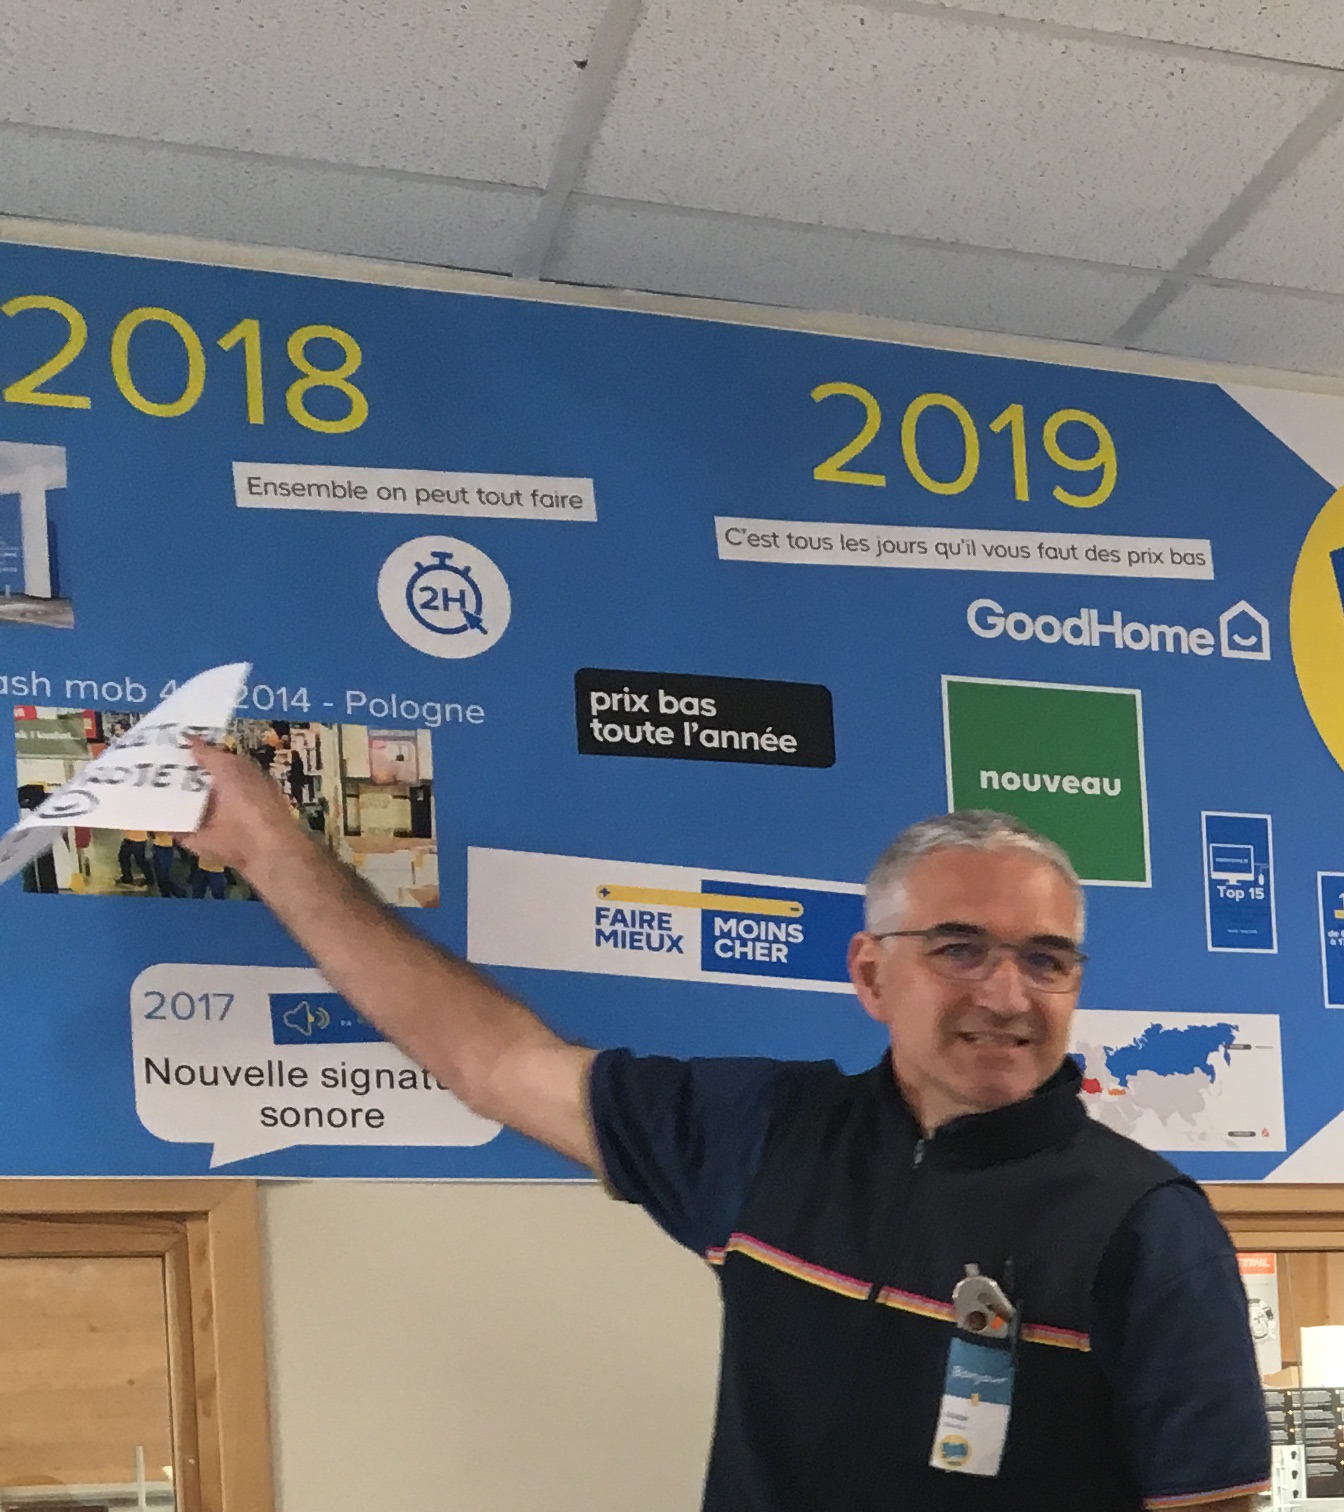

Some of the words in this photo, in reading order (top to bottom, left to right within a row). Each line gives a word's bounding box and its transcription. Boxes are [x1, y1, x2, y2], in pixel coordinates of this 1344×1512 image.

[1, 295, 369, 434] 2018
[811, 381, 1118, 508] 2019
[247, 475, 368, 502] Ensemble
[376, 485, 406, 501] on
[415, 486, 469, 509] peut
[476, 487, 523, 508] tout
[530, 488, 583, 511] faire
[725, 527, 780, 549] C'est
[786, 533, 834, 552] tous
[840, 533, 870, 553] les
[875, 536, 928, 556] jours
[934, 539, 976, 560] qu'il
[982, 543, 1031, 560] vous
[1038, 541, 1078, 561] faut
[1085, 544, 1121, 564] des
[1128, 547, 1165, 568] prix
[1170, 547, 1206, 568] bas
[418, 586, 467, 612] 2H
[966, 597, 1215, 657] GoodHome
[66, 676, 147, 703] mob
[345, 690, 485, 728] Pologne
[589, 687, 651, 716] prix
[659, 690, 717, 718] bas
[590, 718, 674, 747] toute
[684, 723, 798, 754] l'année
[979, 768, 1122, 797] nouveau
[1217, 885, 1245, 902] Top
[1249, 887, 1265, 900] 15
[595, 906, 673, 933] FAIRE
[714, 916, 804, 944] MOINS
[595, 928, 684, 955] MIEUX
[714, 939, 789, 964] CHER
[143, 990, 235, 1022] 2017
[145, 1056, 309, 1089] Nouvelle
[260, 1105, 386, 1130] sonore
[1240, 1257, 1271, 1268] TIHL
